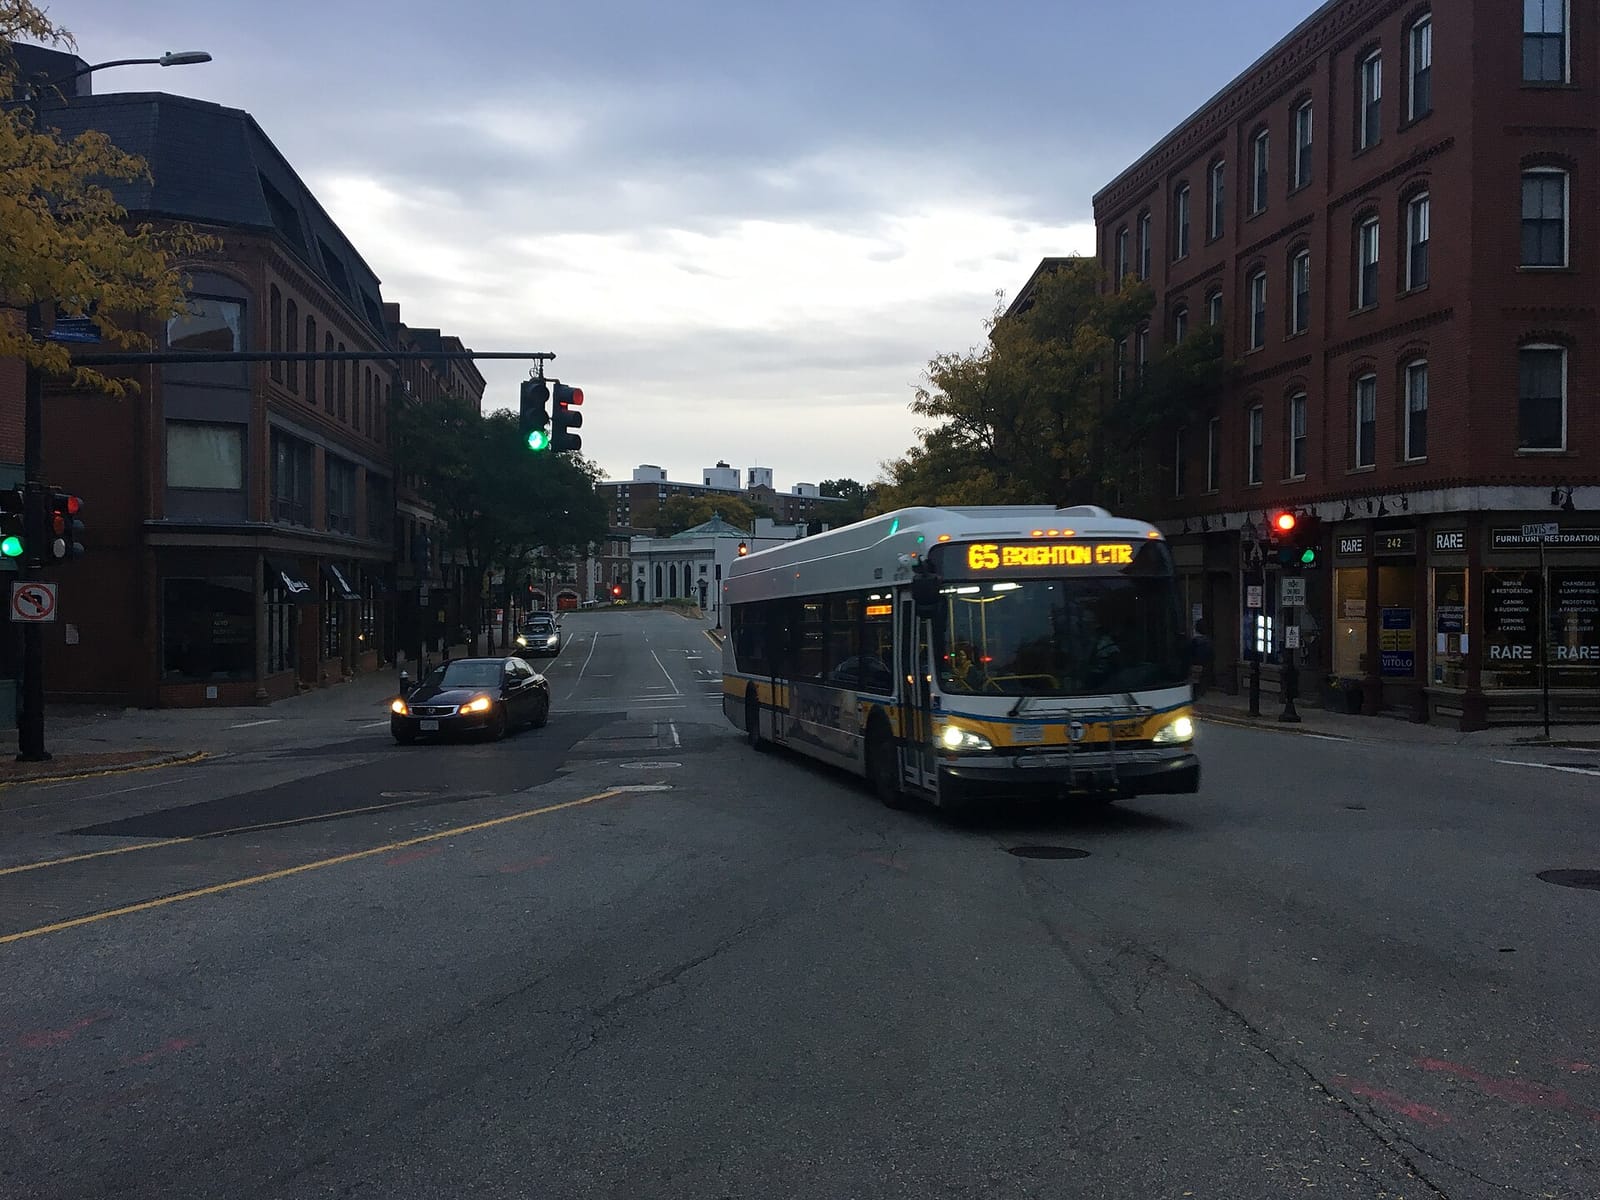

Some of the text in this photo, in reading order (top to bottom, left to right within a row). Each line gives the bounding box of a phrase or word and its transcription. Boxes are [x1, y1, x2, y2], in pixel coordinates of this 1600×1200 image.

[1524, 525, 1546, 536] DAVIS
[1387, 538, 1402, 548] 242
[1436, 533, 1464, 549] RARE
[1544, 534, 1600, 543] RESTORATION
[1341, 539, 1363, 553] RARE
[968, 544, 1133, 569] 65 BRIGHTON CTR
[1490, 645, 1532, 659] RARE
[1557, 645, 1600, 659] RARE
[1382, 658, 1413, 667] VITOLO
